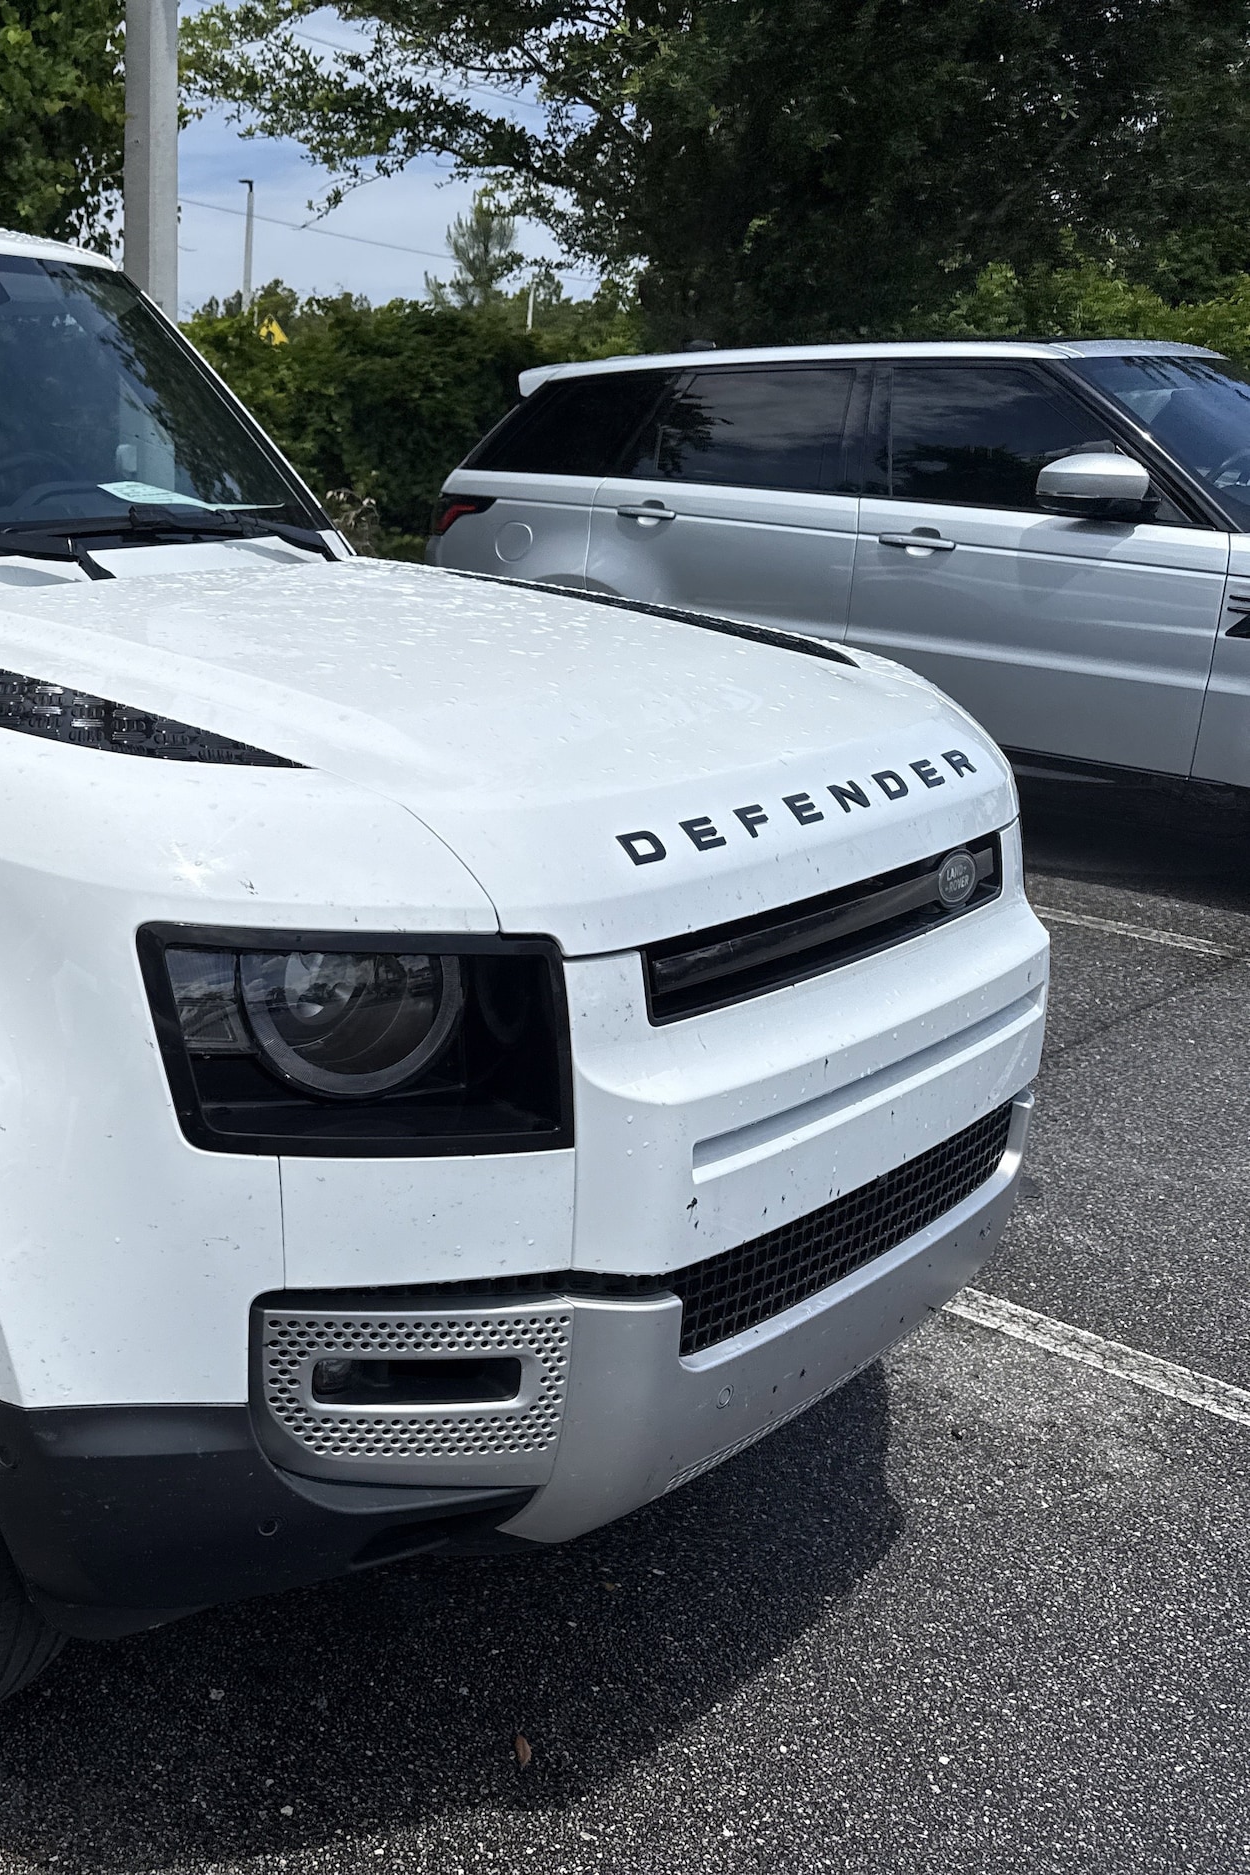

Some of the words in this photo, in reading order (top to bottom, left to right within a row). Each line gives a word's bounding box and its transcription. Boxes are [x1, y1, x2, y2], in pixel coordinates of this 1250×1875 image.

[615, 749, 978, 866] DEFENDER
[946, 864, 964, 882] LAND
[949, 874, 970, 893] ROVER
